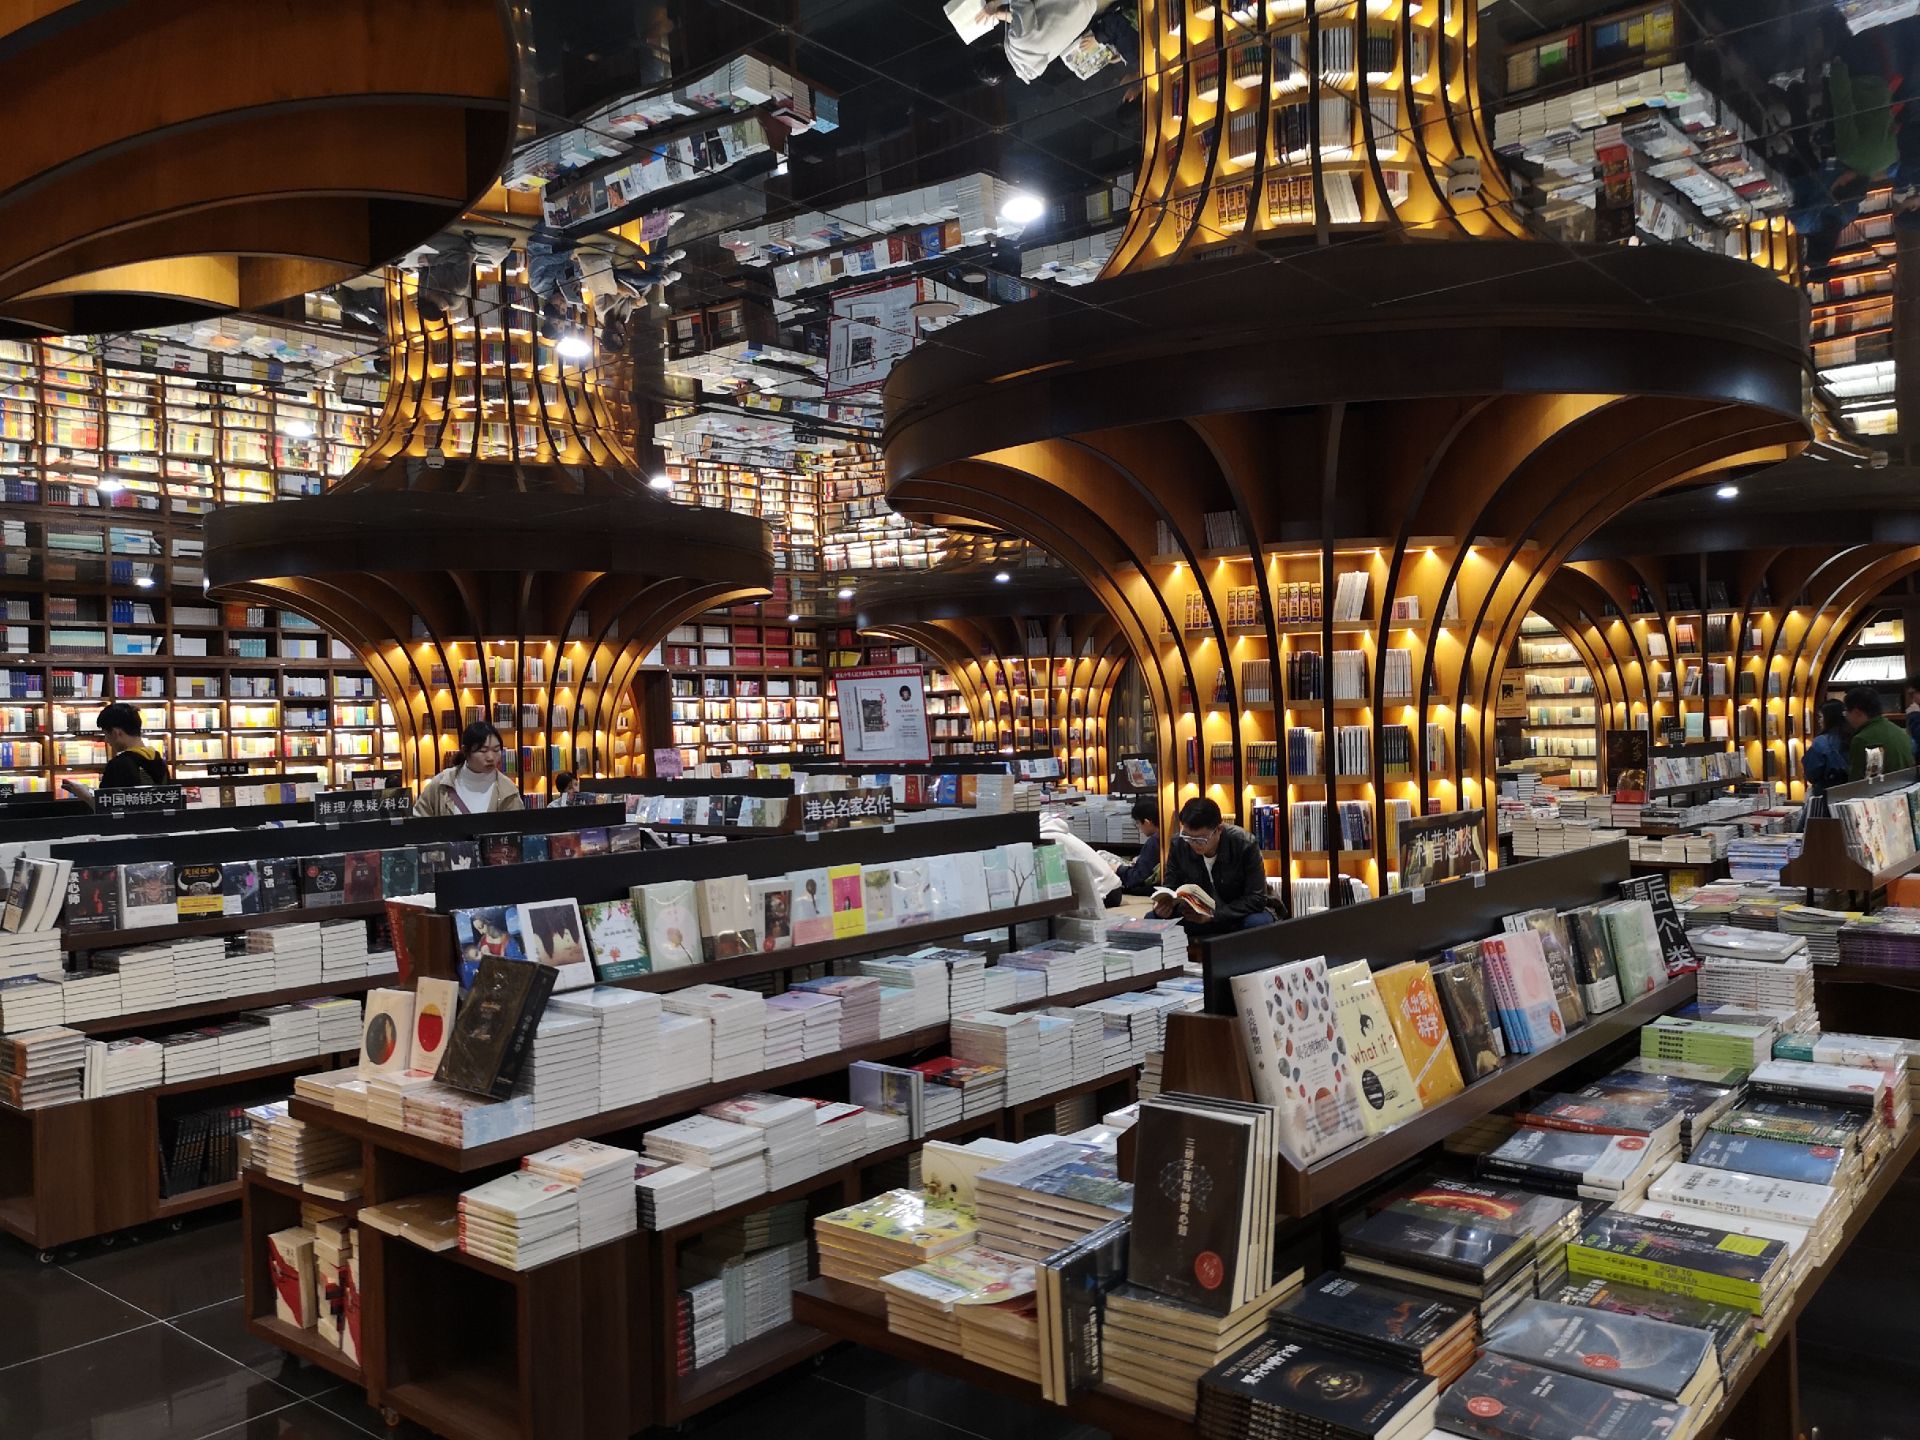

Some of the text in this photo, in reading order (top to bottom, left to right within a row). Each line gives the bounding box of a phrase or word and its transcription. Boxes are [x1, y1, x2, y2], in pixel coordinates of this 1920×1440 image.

[98, 789, 180, 807] 中国畅销文学
[318, 796, 411, 816] 推理/悬疑/科幻
[805, 793, 892, 821] 港台名家名作
[1415, 823, 1472, 866] 科普趣谈
[1350, 1041, 1378, 1065] what
